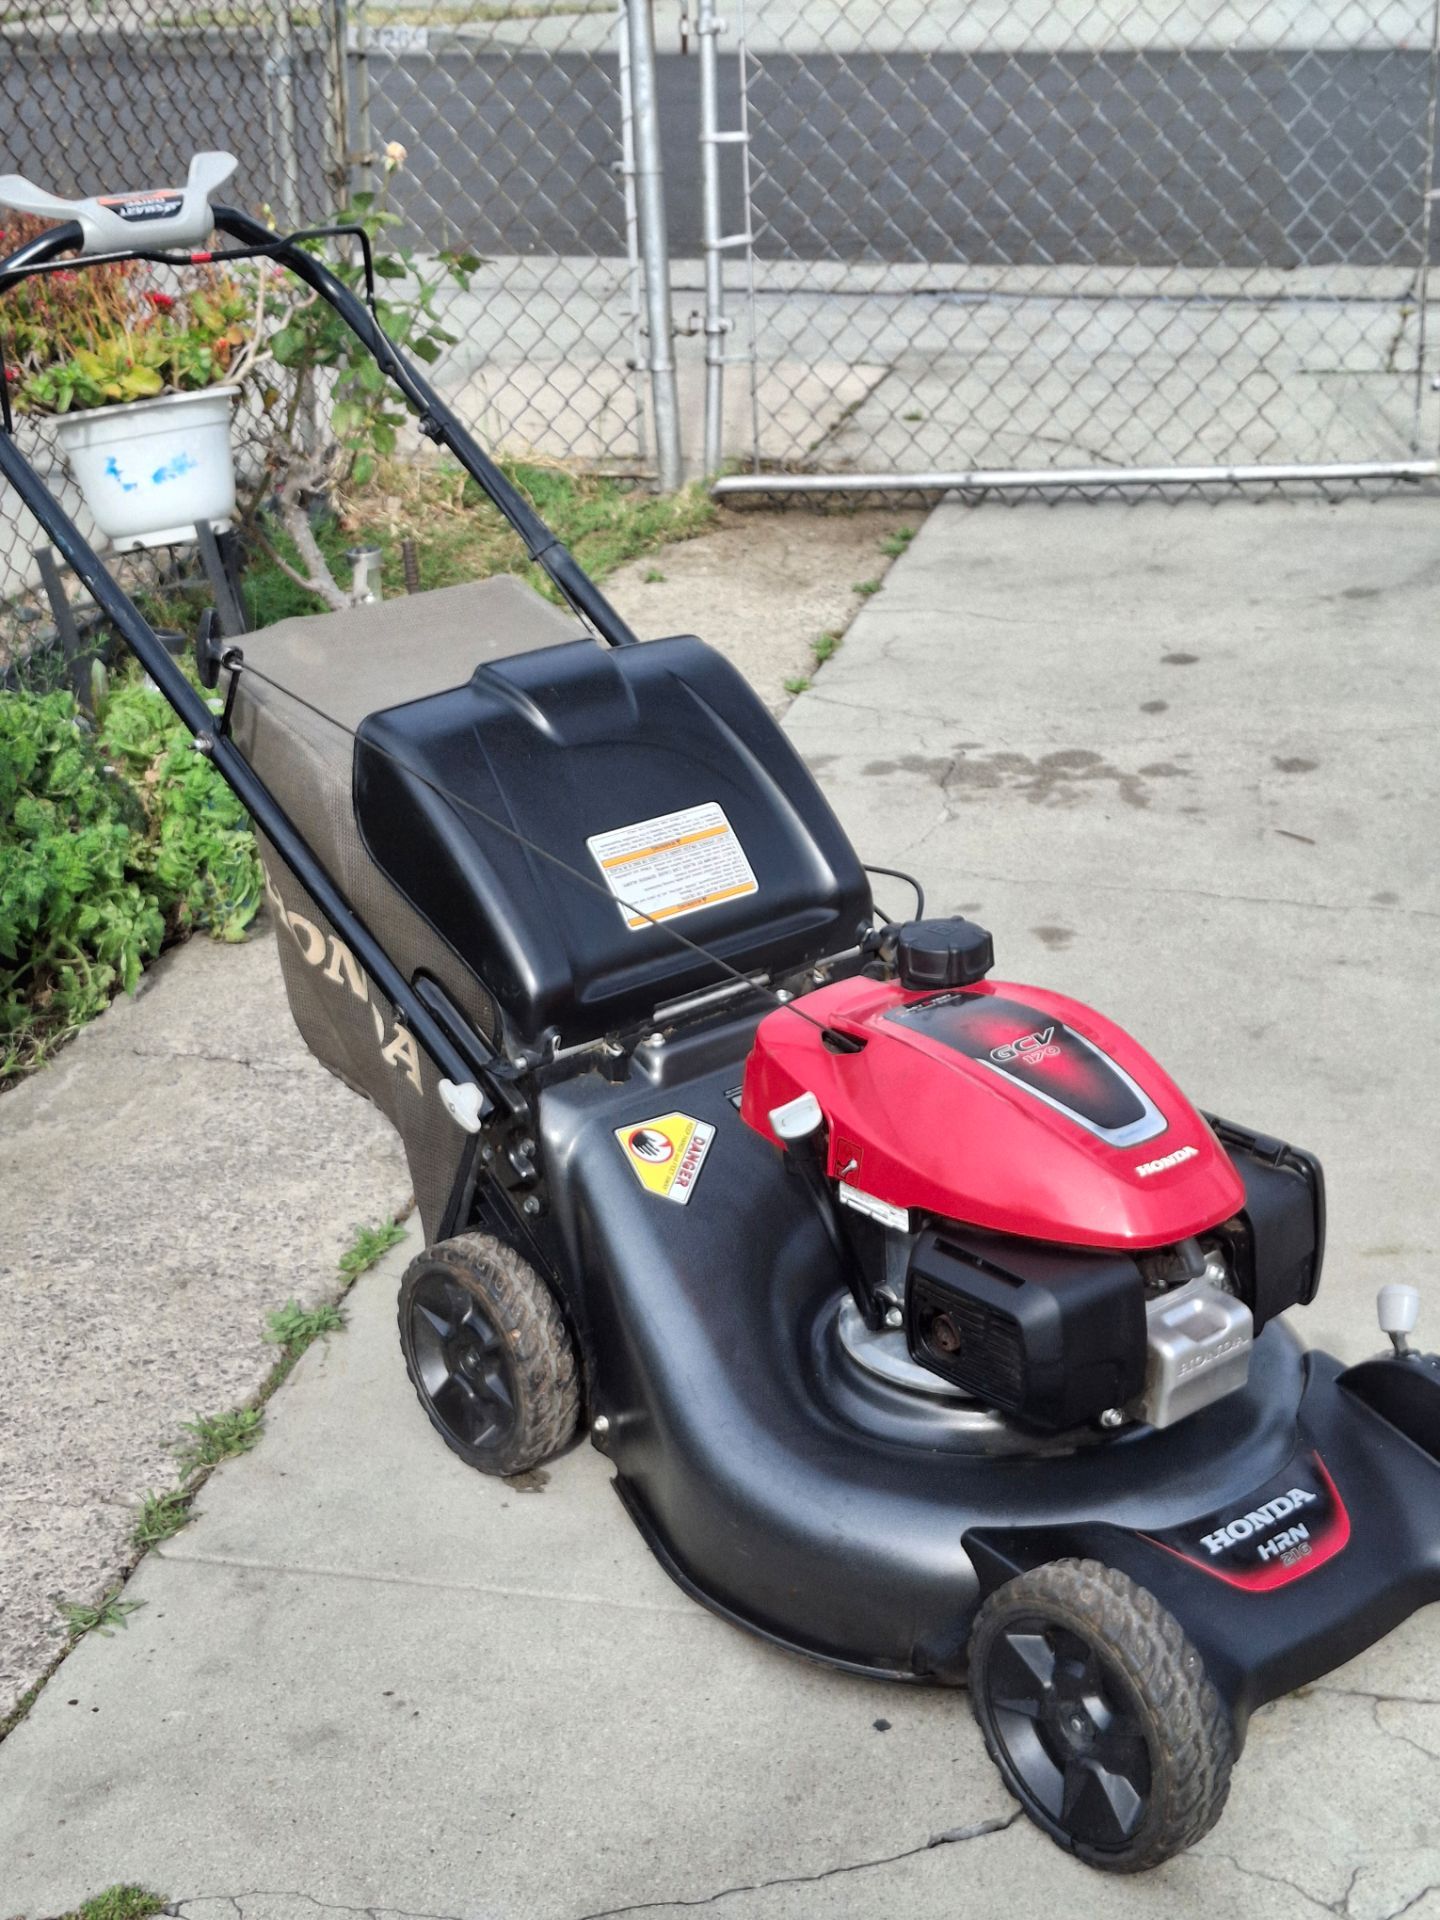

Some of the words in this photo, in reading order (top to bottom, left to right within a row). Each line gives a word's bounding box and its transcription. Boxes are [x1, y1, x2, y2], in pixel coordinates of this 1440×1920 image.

[265, 872, 424, 1096] ONA
[990, 1026, 1055, 1062] GCV
[1023, 1045, 1061, 1064] 170
[676, 1136, 705, 1187] DANGER
[1135, 1145, 1199, 1177] HONDA
[1199, 1488, 1317, 1554] HONDA
[1257, 1523, 1310, 1561] HRN
[1280, 1542, 1313, 1567] 216
